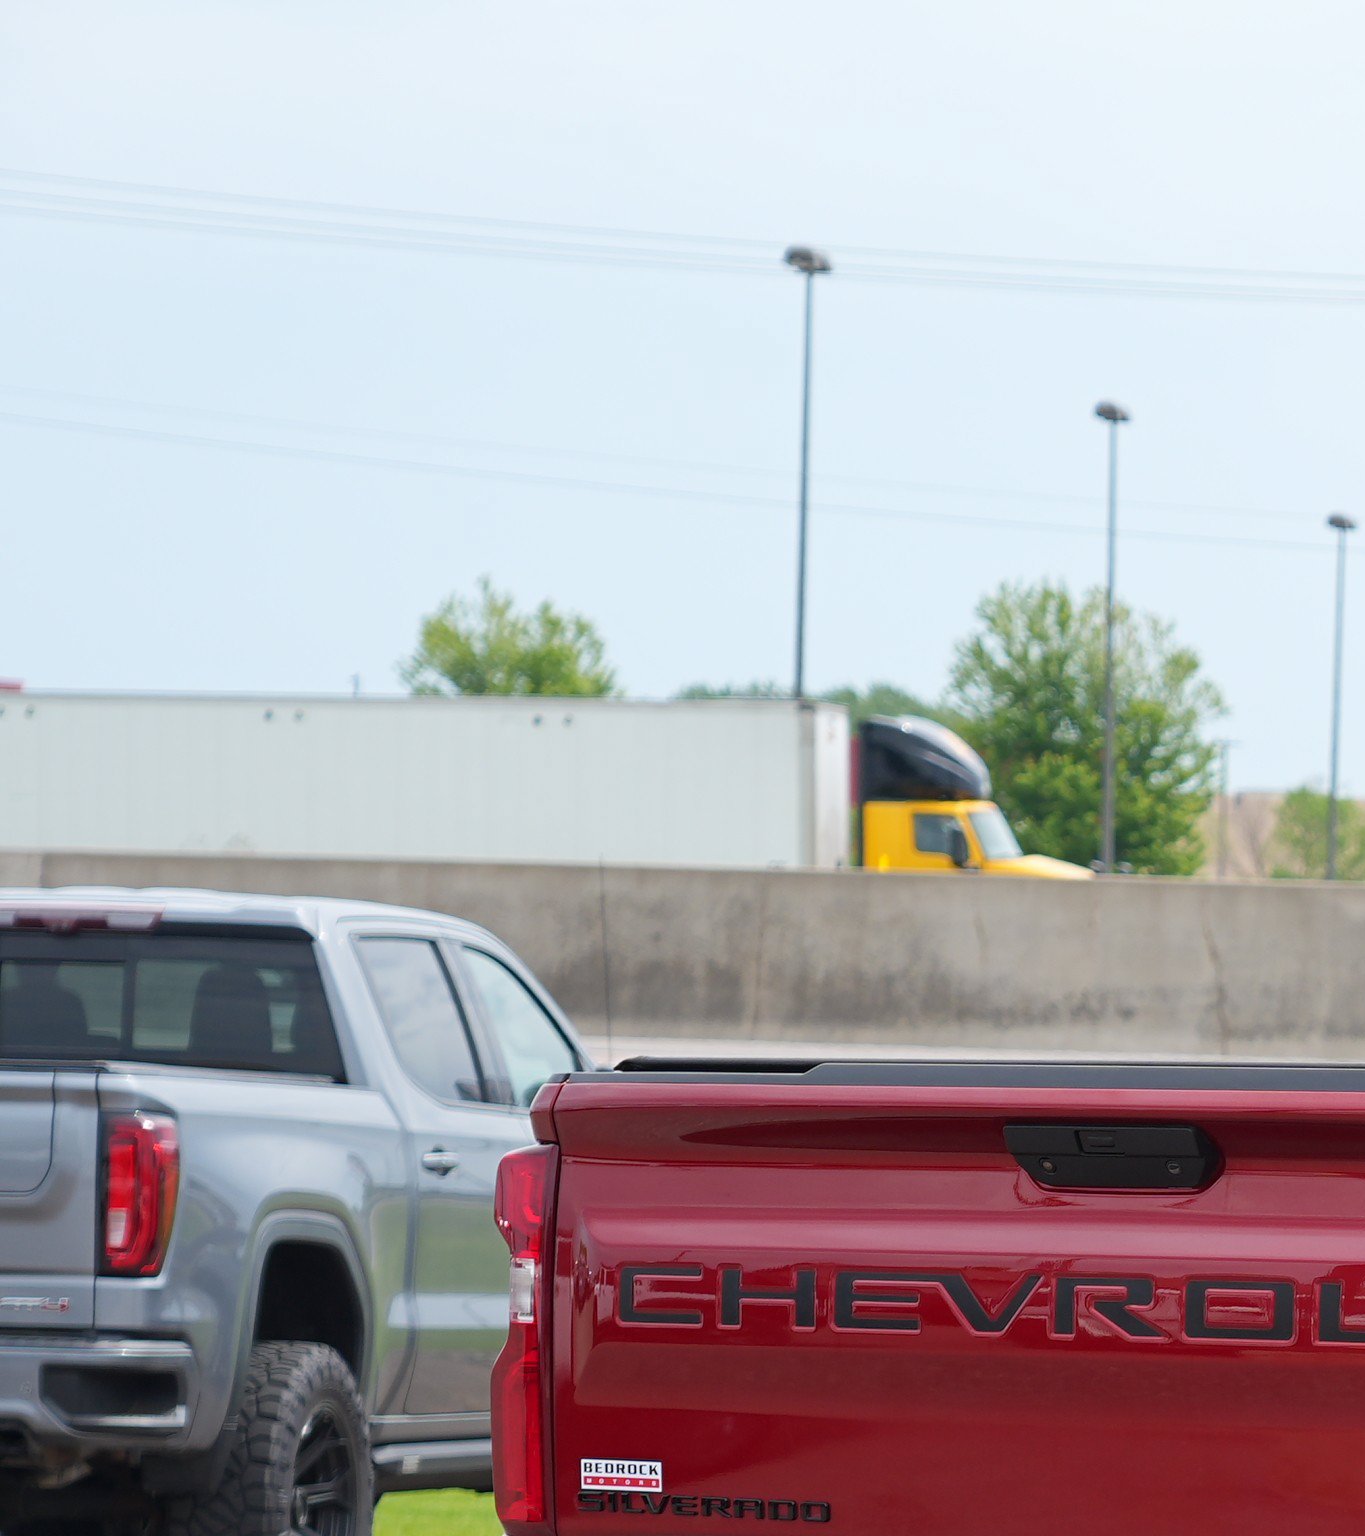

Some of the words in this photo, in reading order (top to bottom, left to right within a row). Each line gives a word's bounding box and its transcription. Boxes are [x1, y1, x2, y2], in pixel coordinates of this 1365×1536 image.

[583, 1462, 659, 1476] BEDROCK
[585, 1477, 658, 1487] MOTORS
[576, 1491, 832, 1523] SILVERADO
